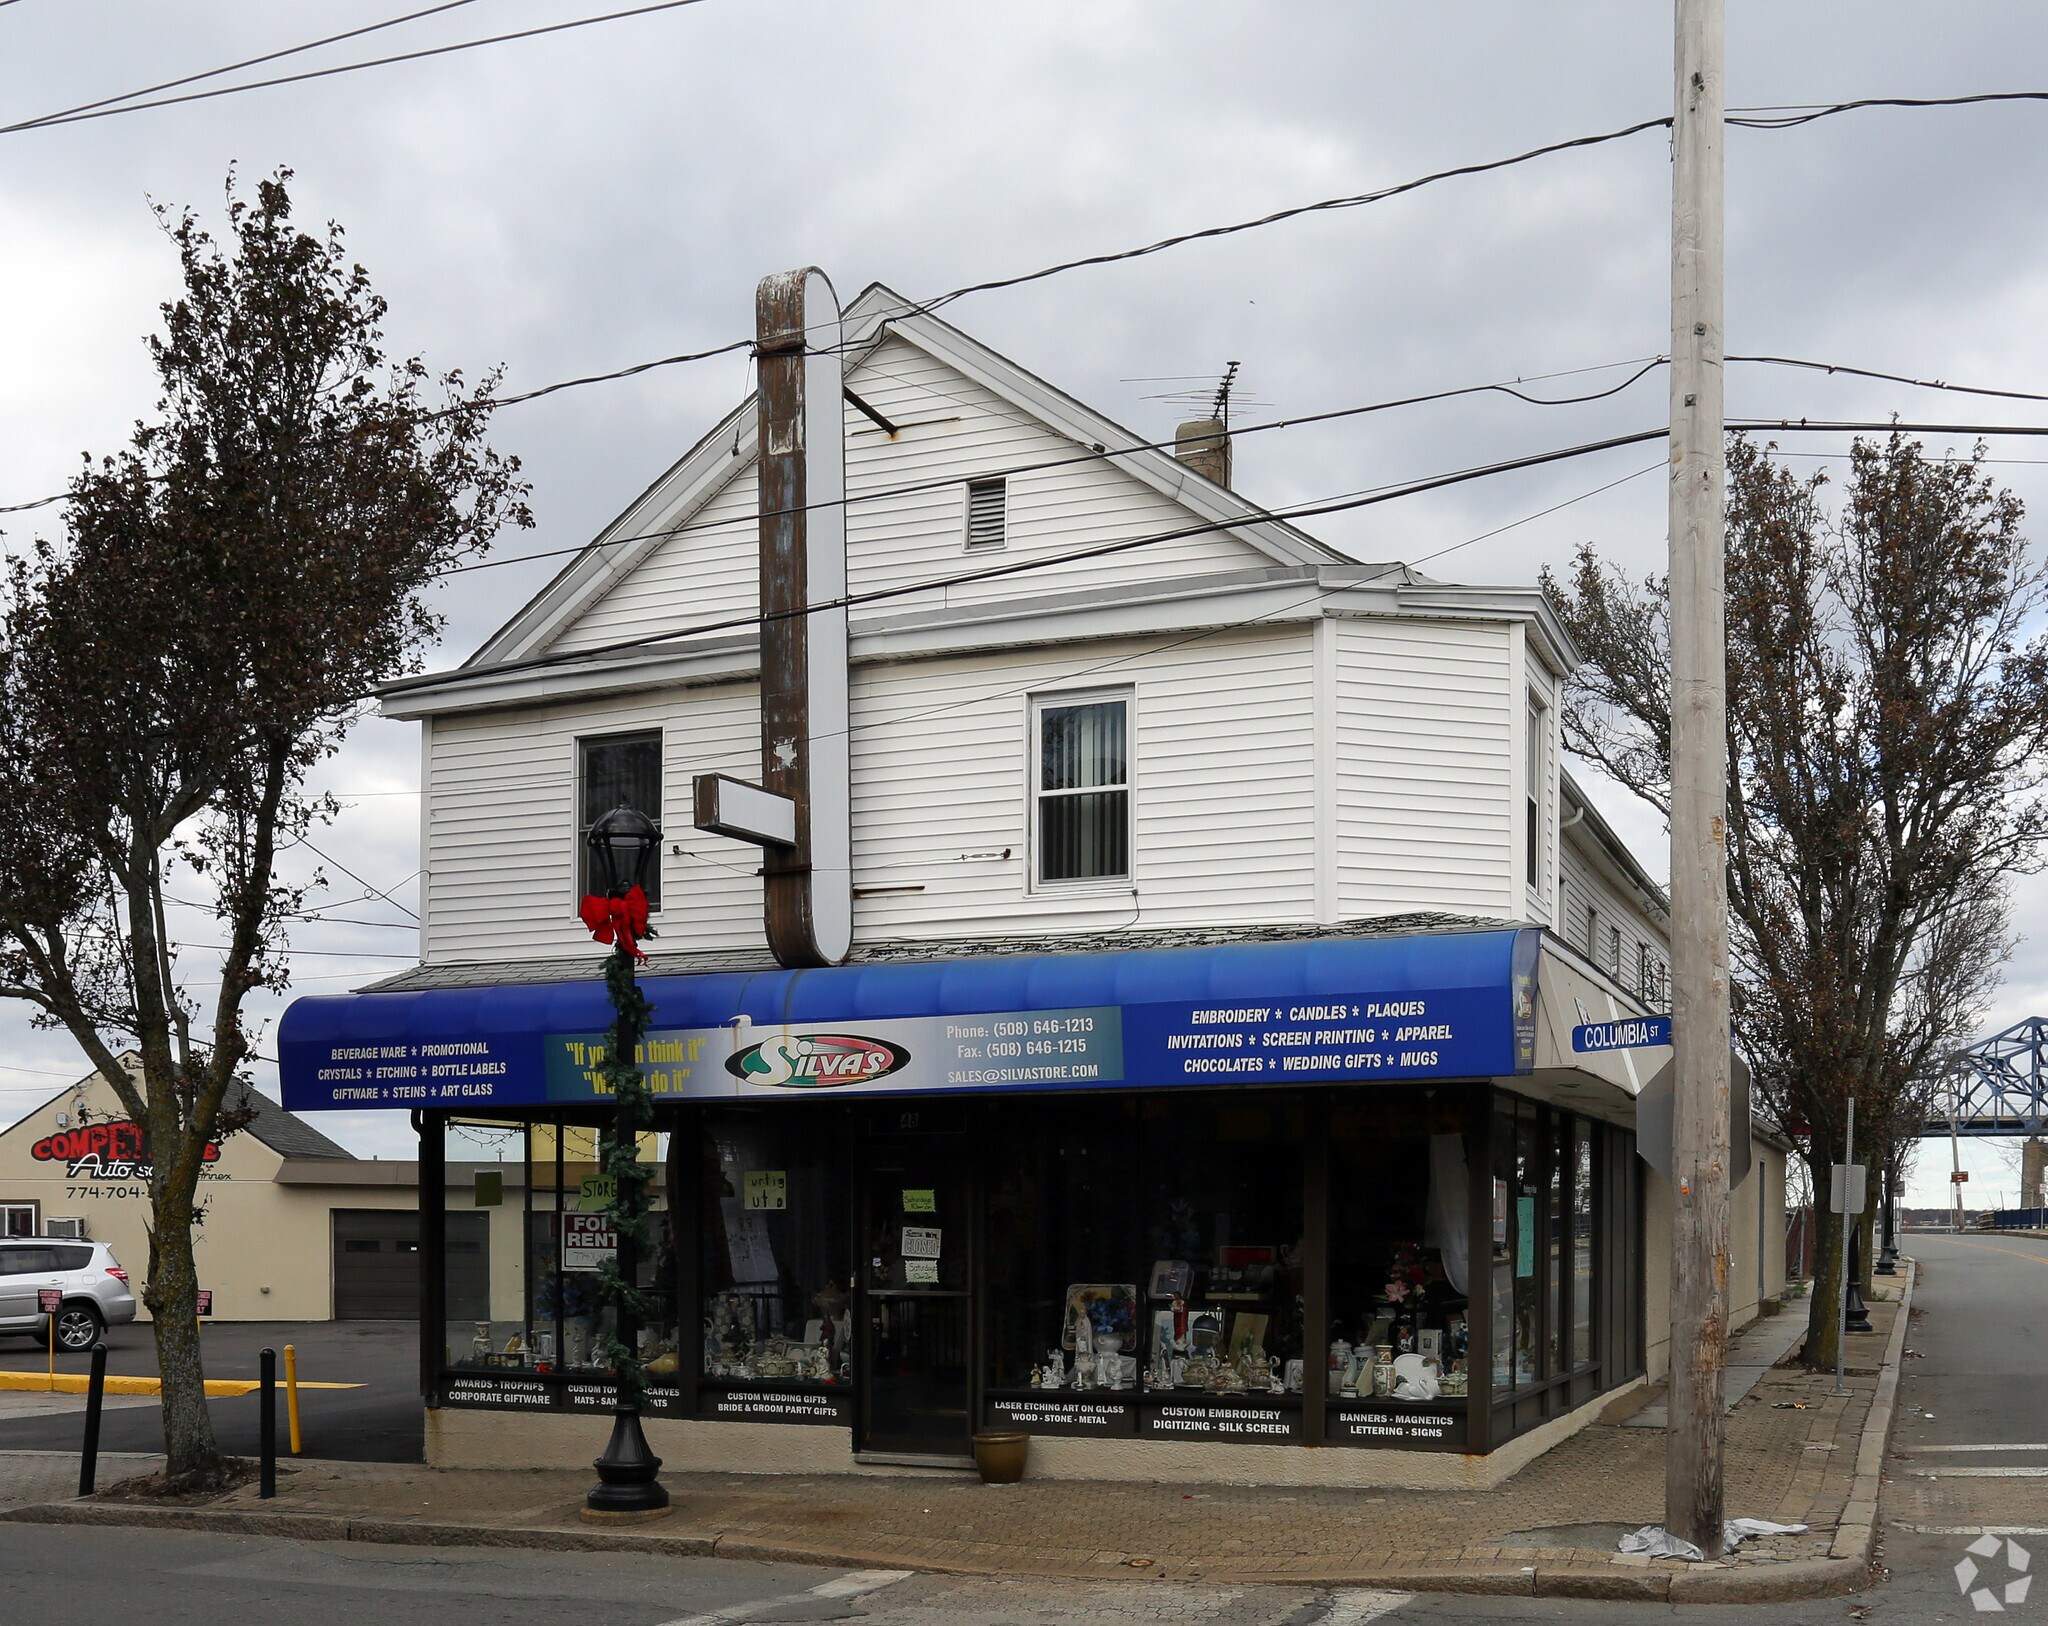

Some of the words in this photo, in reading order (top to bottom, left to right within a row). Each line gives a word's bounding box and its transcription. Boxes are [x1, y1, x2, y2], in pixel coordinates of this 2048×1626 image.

[1192, 1008, 1270, 1024] EMBROIDERY
[1289, 1005, 1347, 1021] CANDLES
[1367, 1001, 1425, 1018] PLAQUES
[947, 1025, 989, 1038] Phone:
[994, 1021, 1028, 1037] (508)
[1034, 1018, 1093, 1034] 646-1213
[1585, 1023, 1649, 1048] COLUMBIA
[1650, 1025, 1659, 1037] ST
[1168, 1034, 1243, 1049] INVITATIONS
[1262, 1031, 1311, 1047] SCREEN
[1314, 1028, 1375, 1045] PRINTING
[1395, 1025, 1453, 1041] APPAREL
[331, 1048, 378, 1060] BEVERAGE
[380, 1046, 407, 1058] WARE
[421, 1042, 489, 1057] PROMOTIONAL
[588, 1046, 605, 1068] yo
[648, 1039, 684, 1062] think
[958, 1045, 982, 1058] Fax:
[987, 1042, 1021, 1058] (508)
[1026, 1039, 1086, 1054] 646-1215
[1184, 1058, 1263, 1072] CHOCOLATES
[1283, 1055, 1341, 1071] WEDDING
[1344, 1053, 1381, 1068] GIFTS
[1400, 1051, 1438, 1066] MUGS
[318, 1068, 362, 1080] CRYSTALS
[376, 1066, 417, 1079] ETCHING
[431, 1064, 468, 1077] BOTTLE
[470, 1062, 507, 1075] LABELS
[948, 1064, 1098, 1083] SALES@SILVASTORE.COM
[651, 1070, 669, 1093] do
[332, 1088, 378, 1100] GIFTWARE
[392, 1086, 427, 1098] STEINS
[440, 1085, 459, 1097] ART
[462, 1083, 493, 1096] GLASS
[70, 1153, 134, 1177] Auto
[567, 1232, 618, 1247] RENT
[905, 1238, 937, 1255] CLOSED
[454, 1380, 492, 1389] AWARDS
[568, 1385, 600, 1394] CUSTOM
[449, 1391, 502, 1402] CORPORATE
[504, 1394, 550, 1404] GIFTWARE
[574, 1396, 595, 1404] HATS
[727, 1392, 761, 1401] CUSTOM
[762, 1393, 801, 1403] WEDDING
[803, 1396, 827, 1404] GIFTS
[718, 1403, 742, 1412] BRIDE
[744, 1404, 751, 1412] &
[752, 1404, 783, 1413] GROOM
[785, 1405, 812, 1414] PARTY
[814, 1407, 837, 1417] GIFTS
[995, 1401, 1022, 1410] LASER
[1024, 1402, 1060, 1411] ETCHING
[1062, 1404, 1079, 1412] ART
[1080, 1405, 1093, 1413] ON
[1095, 1405, 1124, 1414] GLASS
[1161, 1407, 1206, 1417] CUSTOM
[1208, 1408, 1281, 1420] EMBROIDERY
[1011, 1413, 1038, 1421] WOOD
[1044, 1414, 1072, 1423] STONE
[1079, 1415, 1107, 1424] METAL
[1153, 1419, 1210, 1431] DIGITIZING
[1219, 1422, 1244, 1433] SILK
[1246, 1423, 1290, 1434] SCREEN
[1340, 1413, 1387, 1423] BANNERS
[1395, 1415, 1454, 1426] MAGNETICS
[1350, 1425, 1403, 1436] LETTERING
[1411, 1427, 1443, 1438] SIGNS
